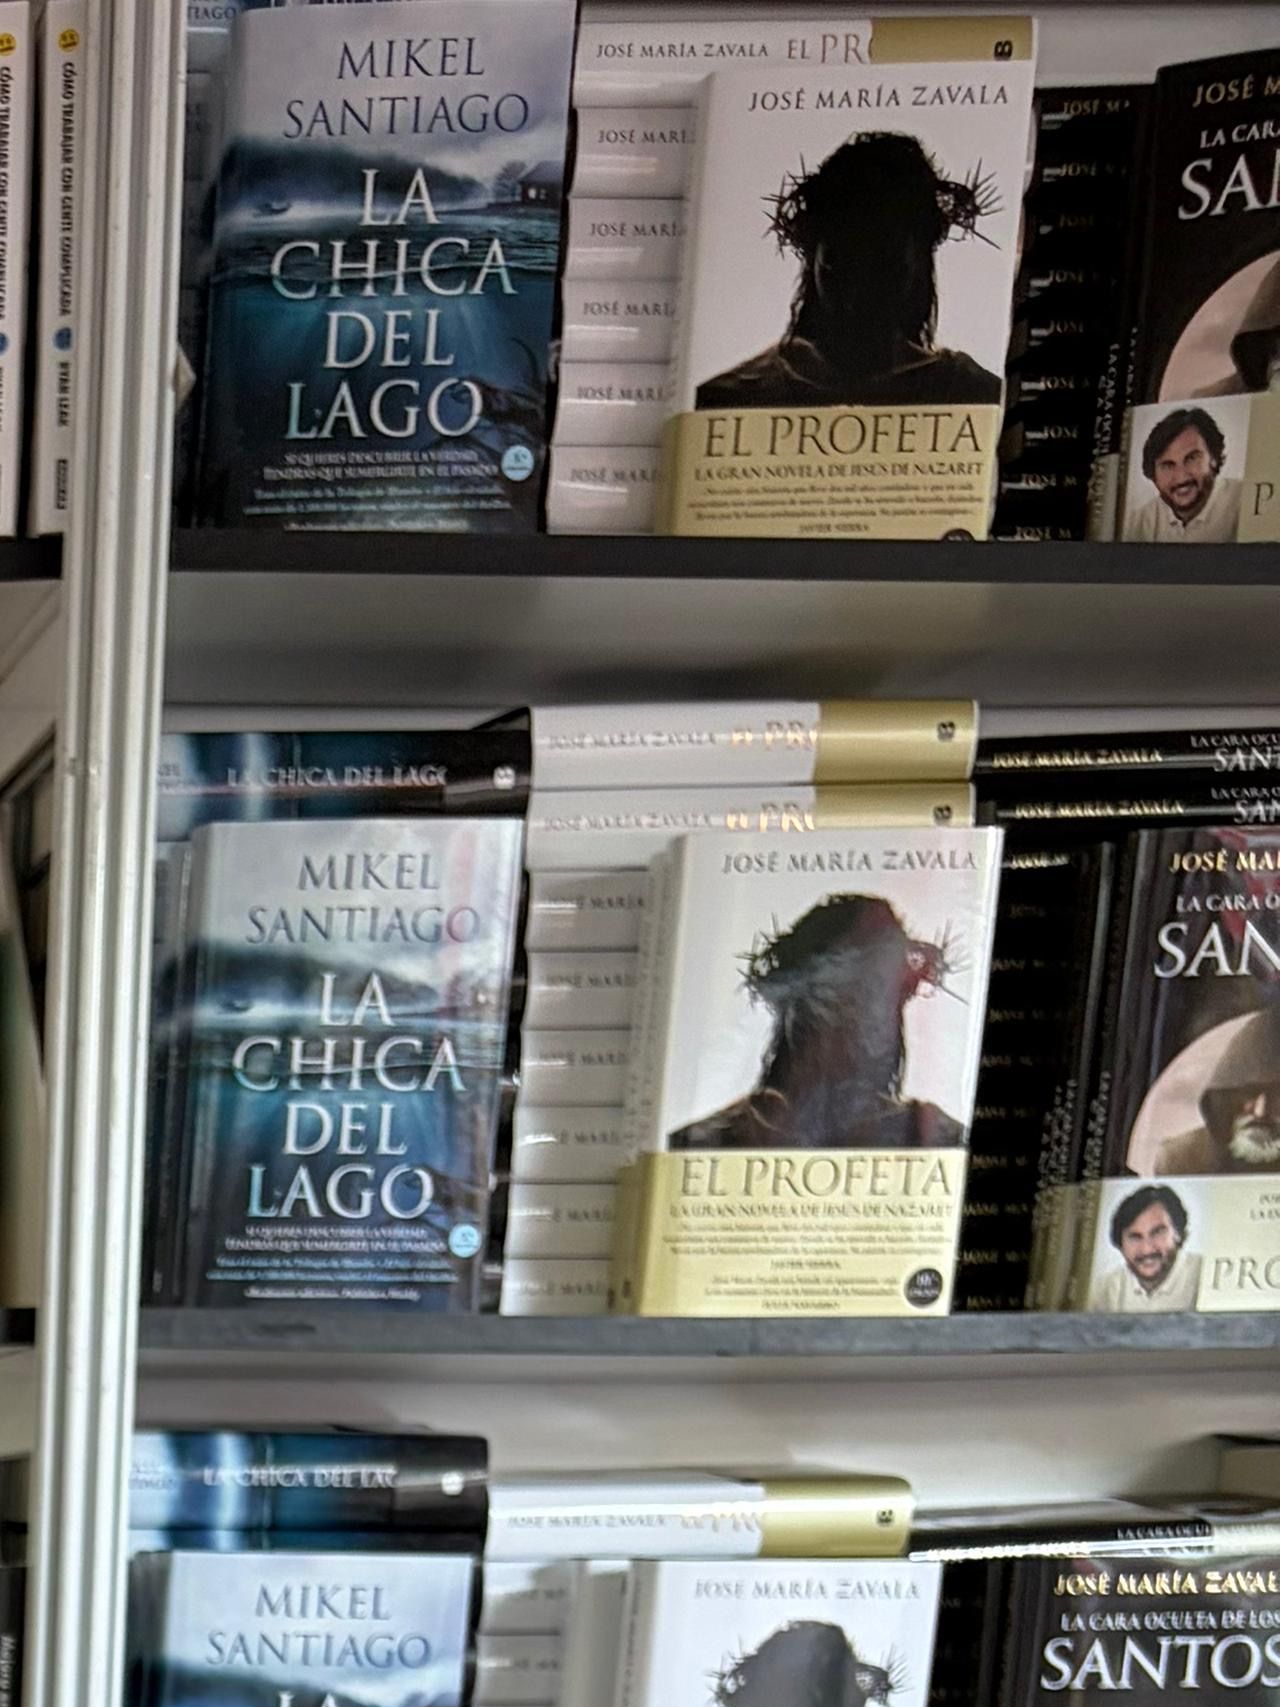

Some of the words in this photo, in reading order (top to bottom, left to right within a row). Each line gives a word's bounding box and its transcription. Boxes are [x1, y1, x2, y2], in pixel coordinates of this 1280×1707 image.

[337, 37, 485, 80] MIKEL
[283, 93, 529, 140] SANTIAGO
[748, 87, 805, 112] JOSÉ
[815, 85, 901, 110] MARÍA
[911, 84, 1008, 106] ZAVALA
[356, 168, 441, 226] LA
[270, 237, 517, 299] CHICA
[325, 308, 454, 368] DEL
[289, 378, 483, 439] LAGO
[704, 416, 751, 458] EL
[769, 412, 982, 456] PROFETA
[298, 853, 438, 891] MIKEL
[243, 906, 478, 947] SANTIAGO
[318, 973, 394, 1026] LA
[233, 1037, 471, 1092] CHICA
[285, 1101, 407, 1155] DEL
[249, 1164, 434, 1219] LAGO
[1041, 1633, 1280, 1690] SANTOS
